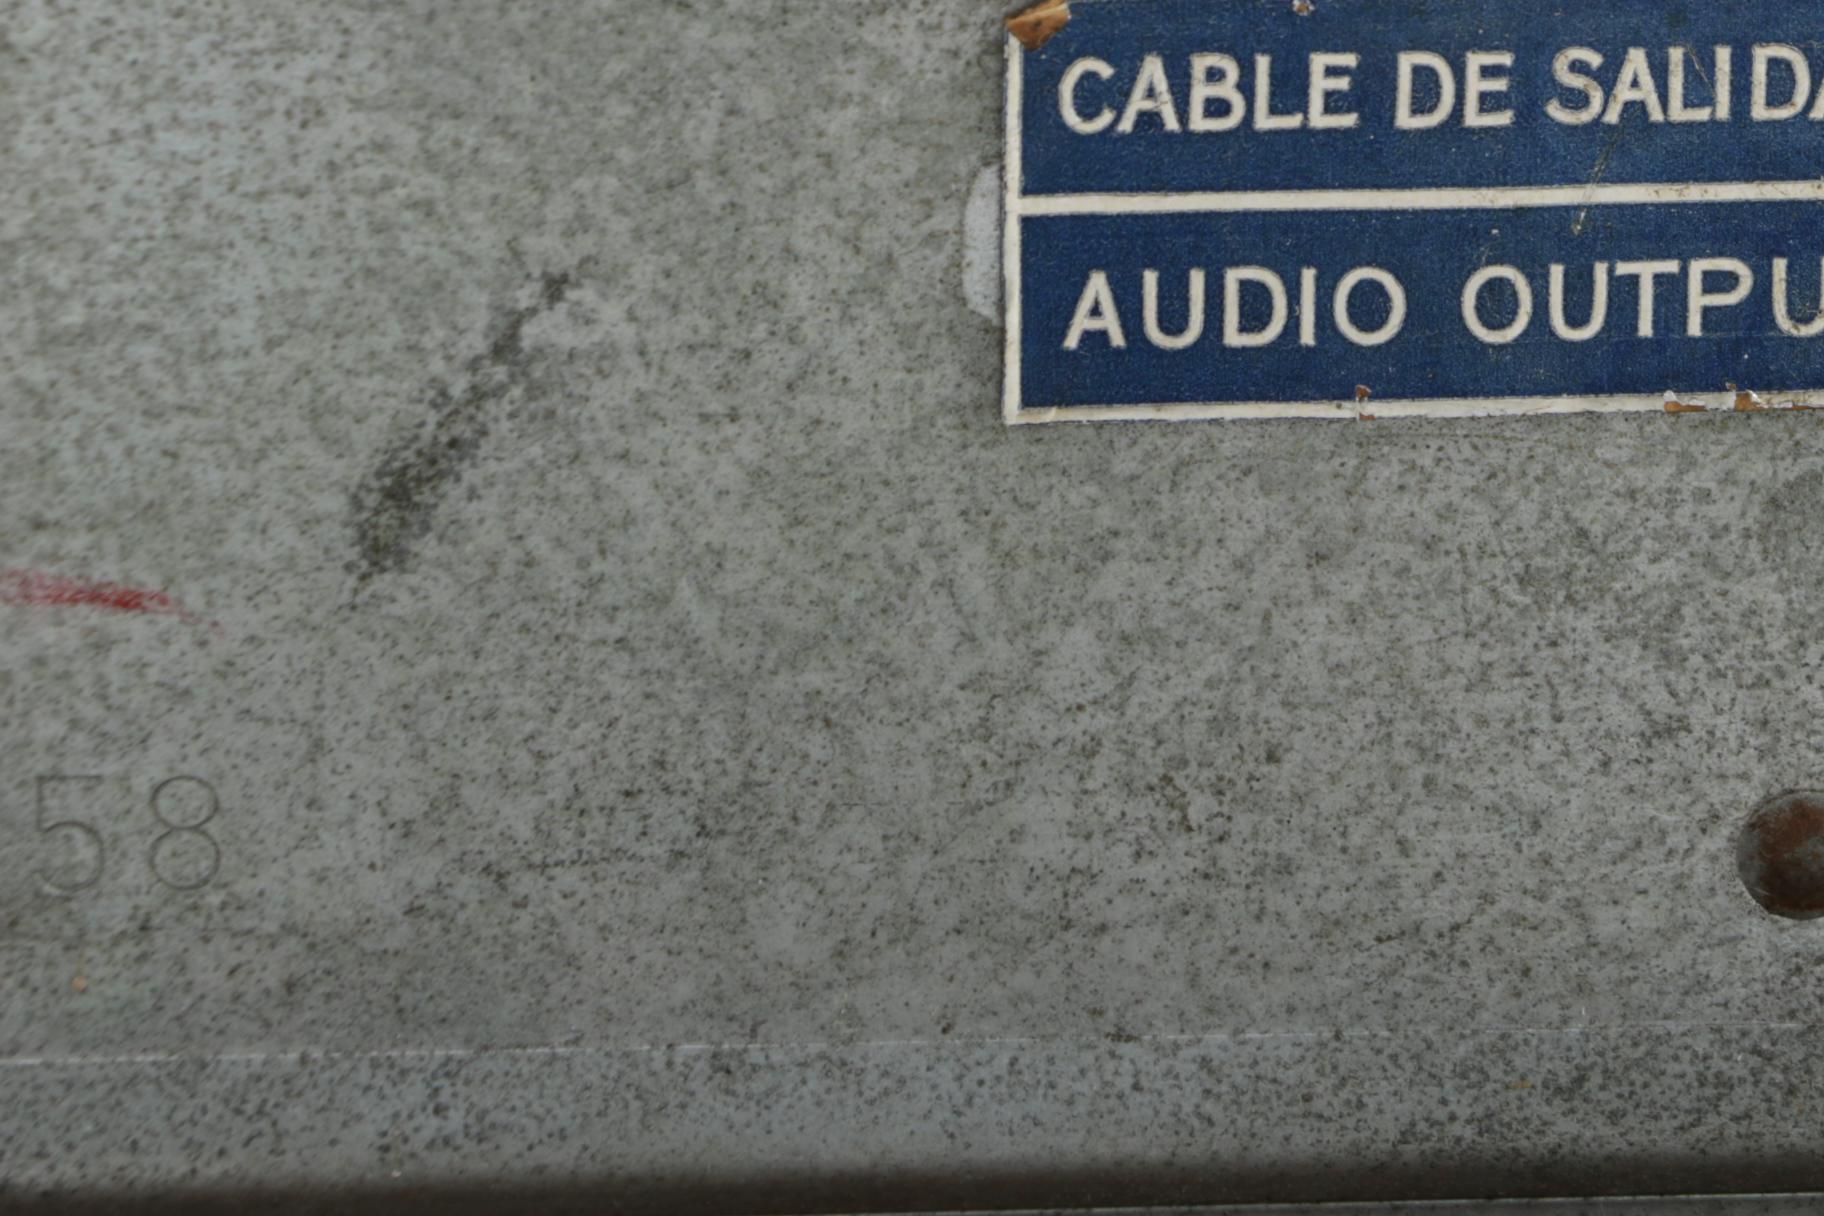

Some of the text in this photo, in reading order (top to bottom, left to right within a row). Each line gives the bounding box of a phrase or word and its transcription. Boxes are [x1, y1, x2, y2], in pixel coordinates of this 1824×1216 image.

[1057, 50, 1361, 135] CABLE
[1394, 49, 1516, 131] DE
[1062, 265, 1407, 351] AUDIO
[34, 773, 221, 891] 58
